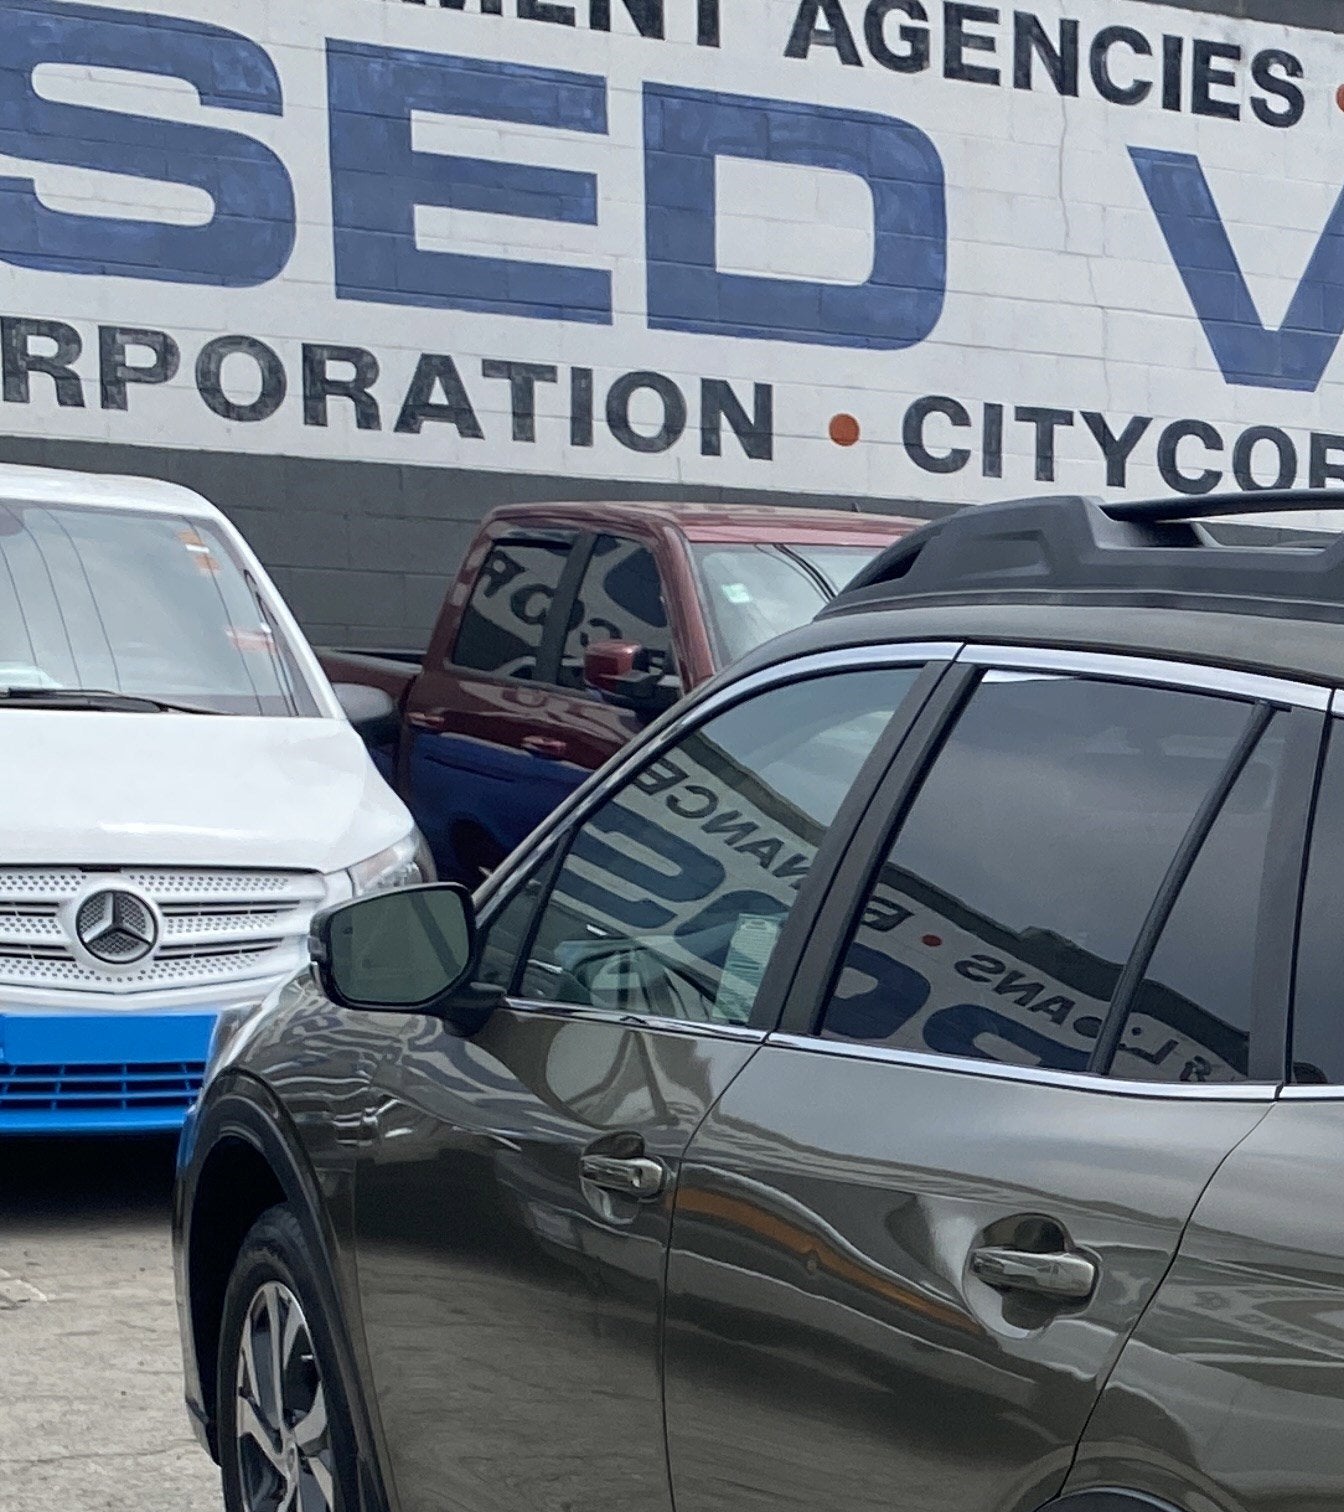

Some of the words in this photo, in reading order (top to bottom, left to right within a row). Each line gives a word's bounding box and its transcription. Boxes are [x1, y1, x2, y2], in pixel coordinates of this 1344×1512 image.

[784, 0, 1304, 128] AGENCIES
[0, 0, 946, 350] SED
[0, 316, 774, 462] RPORATION
